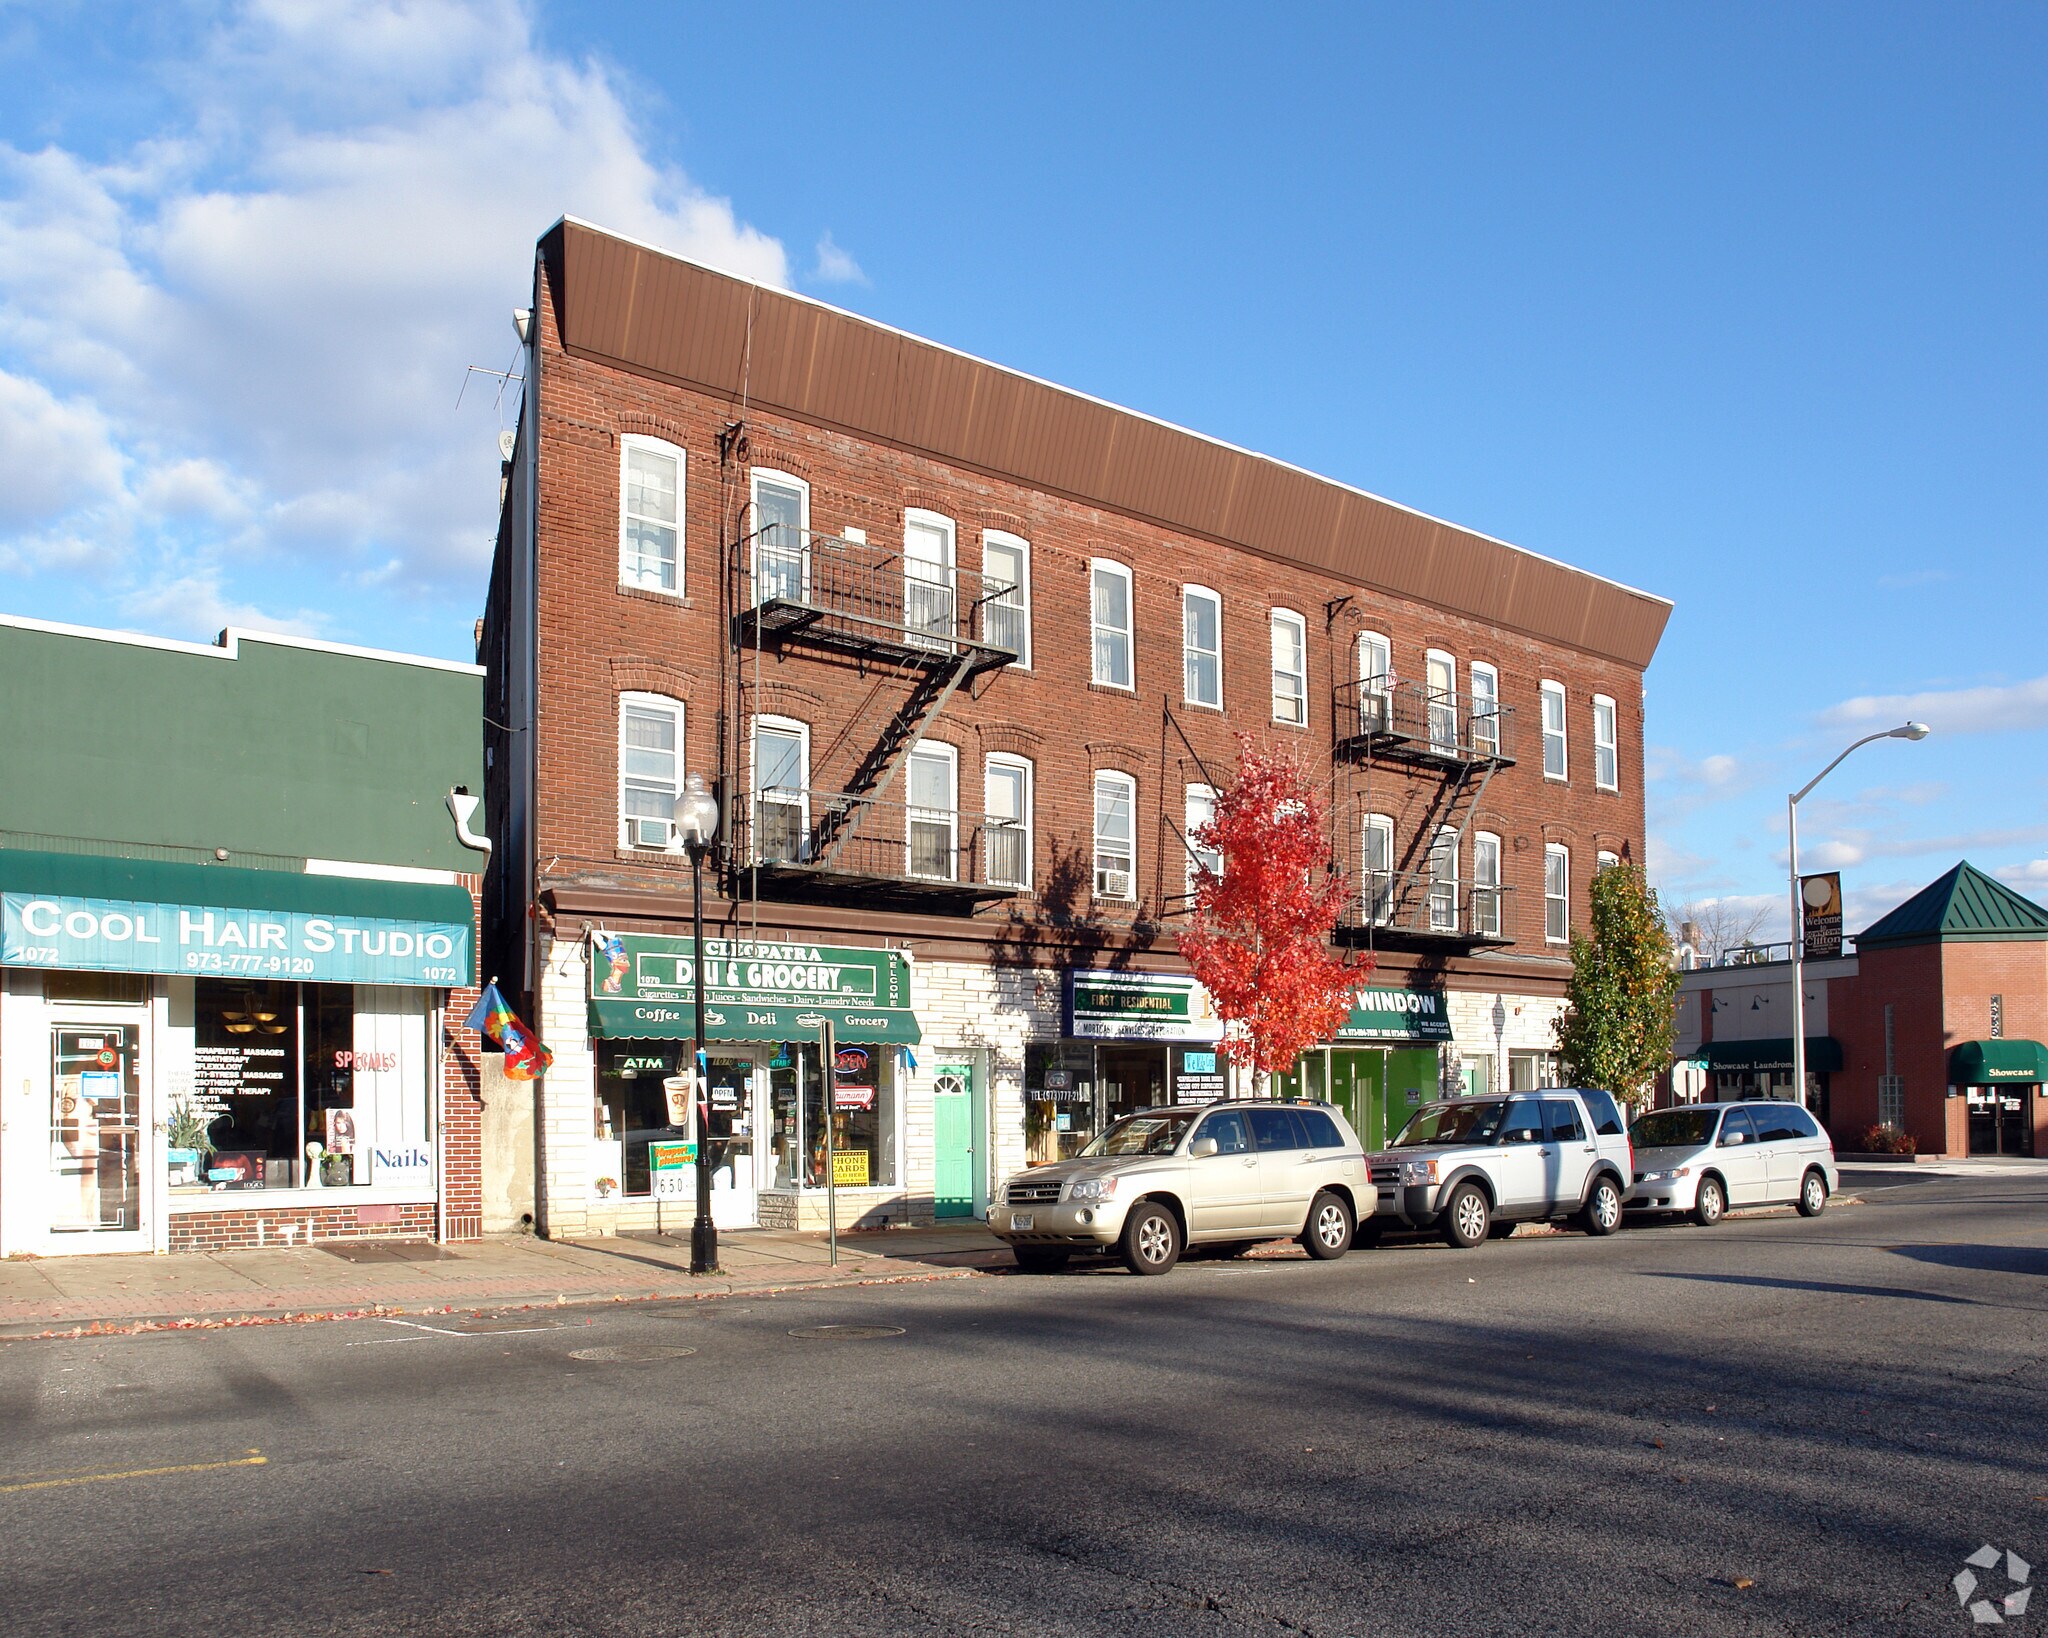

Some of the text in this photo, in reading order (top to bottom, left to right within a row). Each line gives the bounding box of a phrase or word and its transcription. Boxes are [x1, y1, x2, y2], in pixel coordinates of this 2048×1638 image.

[1805, 915, 1842, 926] Welcome
[21, 900, 453, 960] COOL HAIR STUDIO
[1805, 935, 1841, 946] Clifton
[17, 946, 60, 962] 1072
[705, 941, 823, 962] CLEOPATRA
[186, 952, 315, 974] 973-777-9120
[422, 966, 457, 980] 1072
[676, 959, 842, 991] DLI & GROCERY
[888, 953, 899, 1007] WELCOME
[637, 988, 680, 1000] Cigarettes
[686, 990, 710, 1000] Frh
[712, 991, 736, 1001] Juices
[793, 994, 815, 1005] Dairy
[851, 997, 875, 1007] Needs
[1091, 994, 1173, 1010] FIRST RESIDENTIAL
[1356, 990, 1436, 1014] WINDOW
[634, 1007, 680, 1023] Coffee
[747, 1011, 777, 1026] Deli
[844, 1014, 889, 1029] Grocery
[195, 1047, 285, 1056] HERAPEUTIC MASSAGES
[335, 1050, 397, 1069] SPECIALS
[623, 1057, 664, 1069] ATM
[834, 1053, 867, 1069] OPEN
[1713, 1061, 1750, 1070] Showcase
[1754, 1060, 1795, 1069] Laundrom
[1988, 1068, 2035, 1077] Showcase
[237, 1087, 272, 1095] THERAPY
[375, 1149, 429, 1168] Nails
